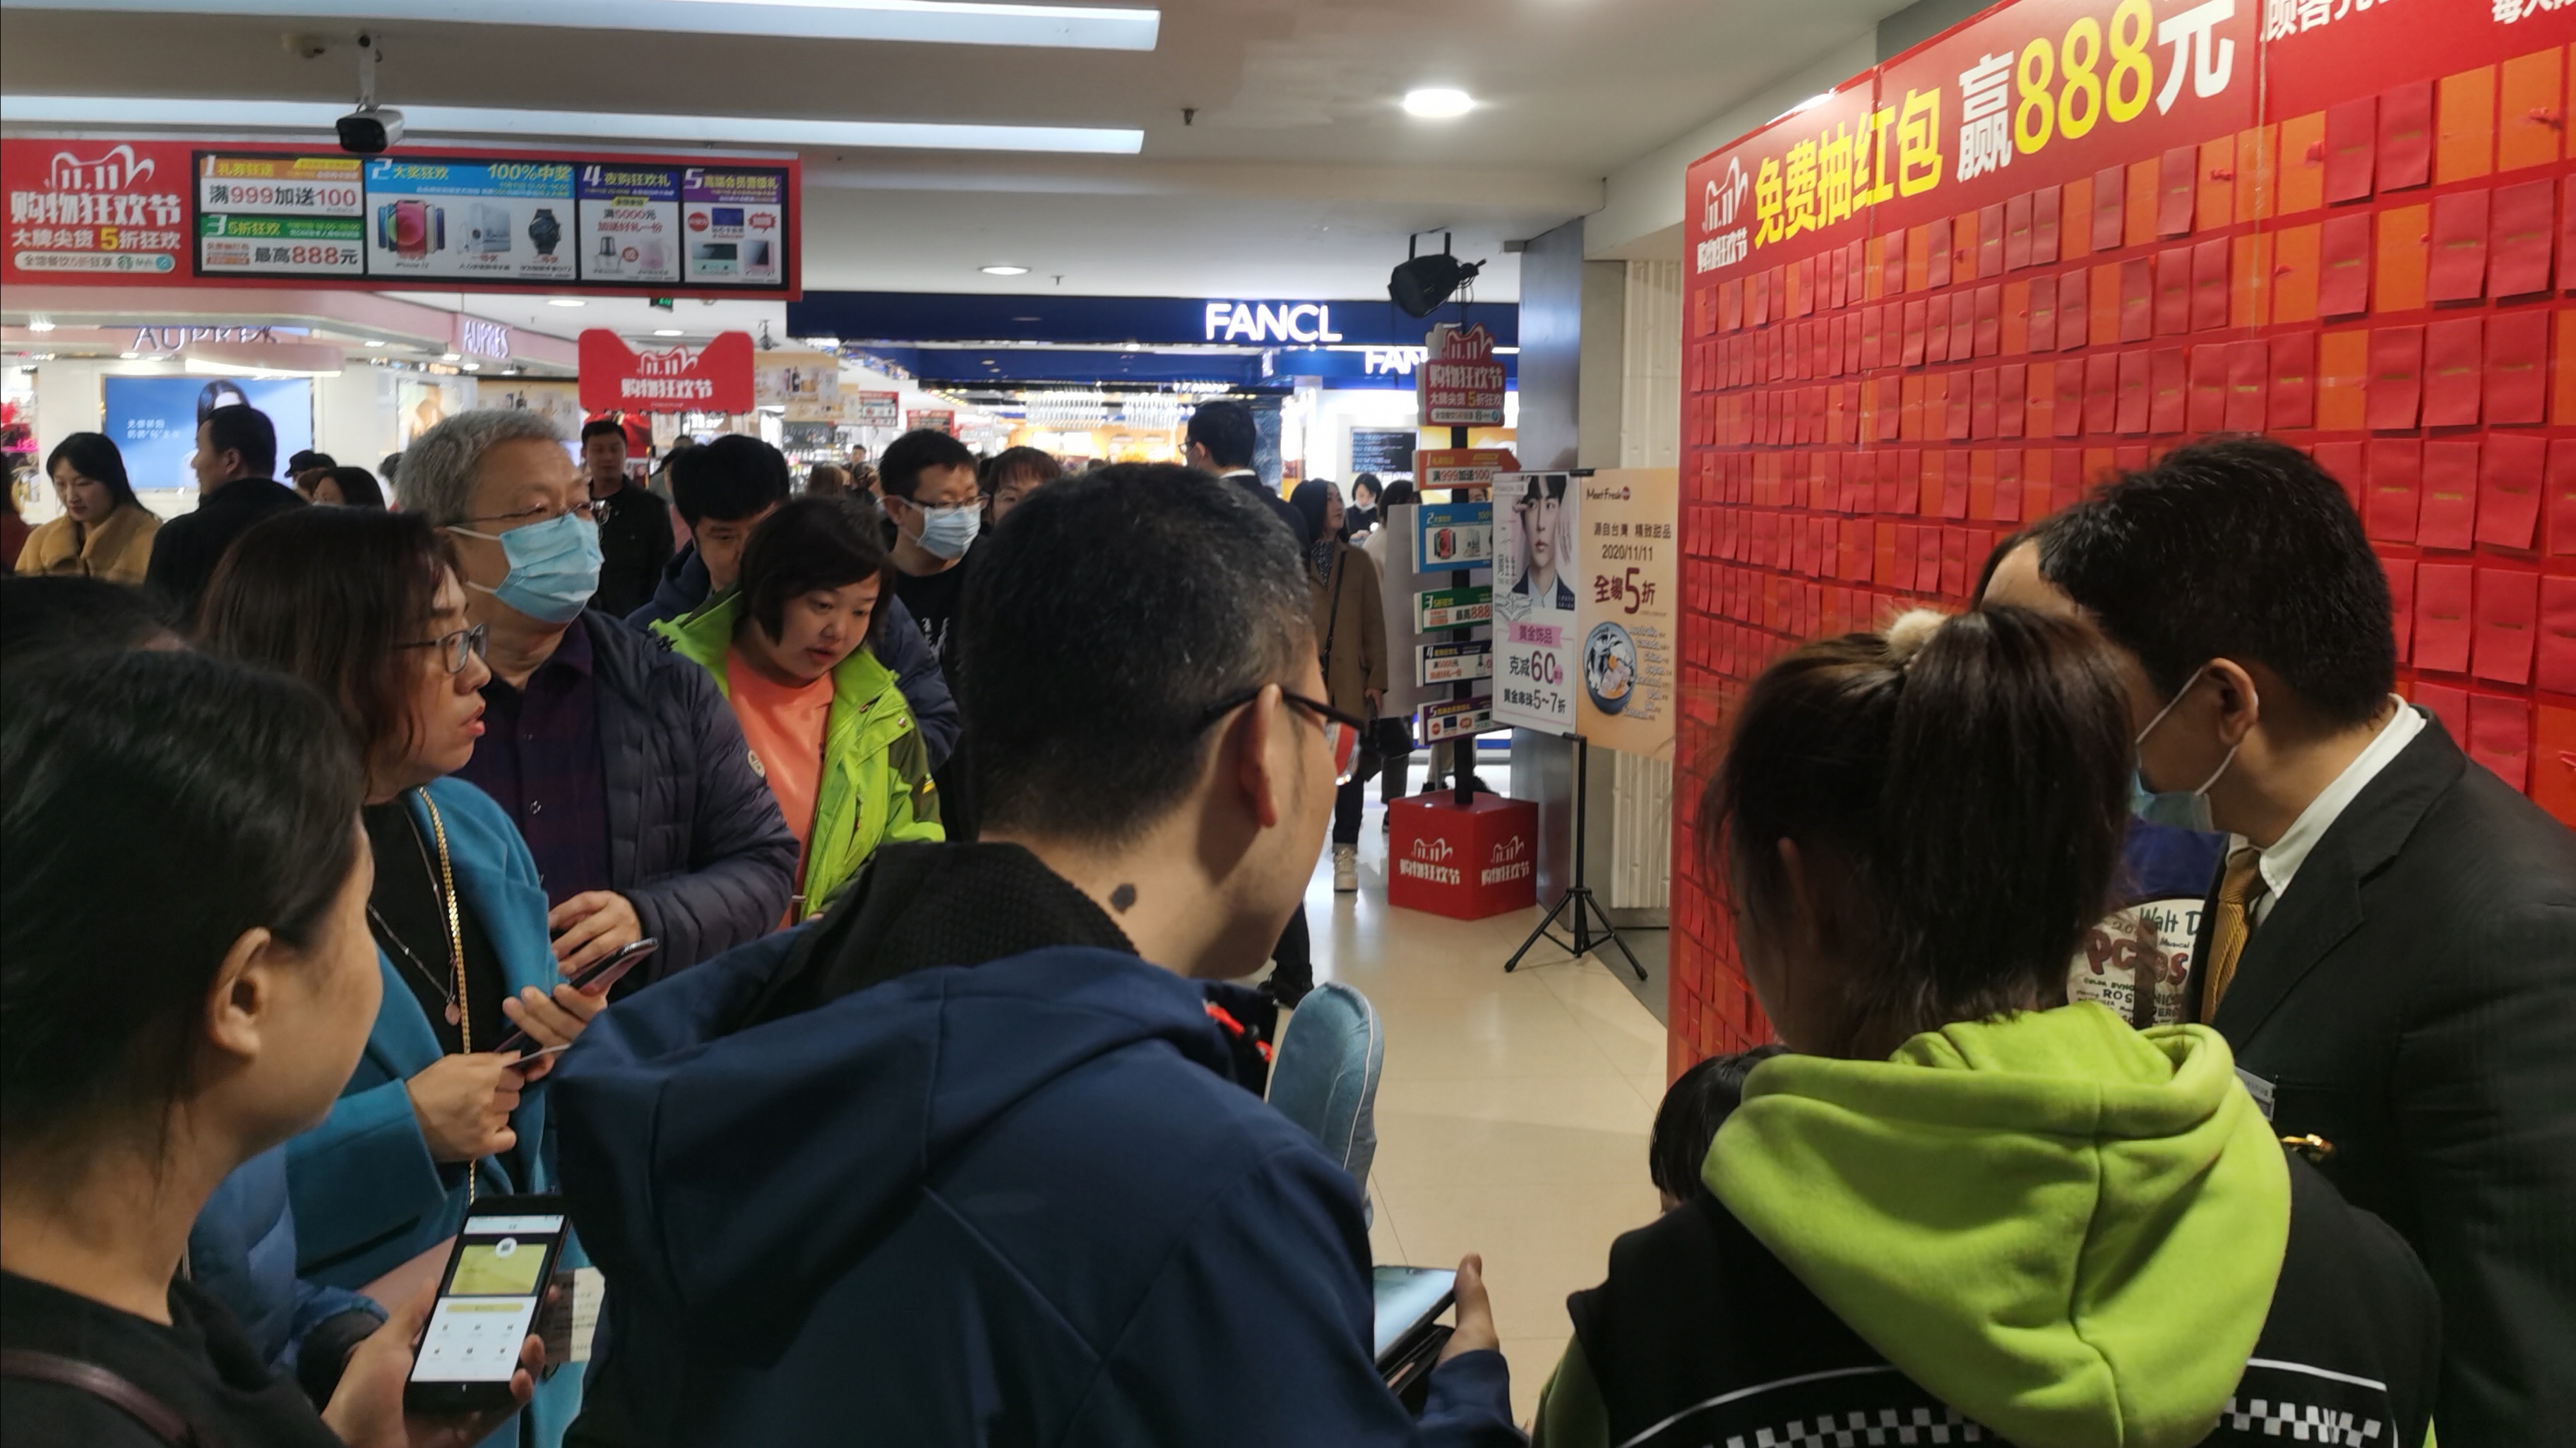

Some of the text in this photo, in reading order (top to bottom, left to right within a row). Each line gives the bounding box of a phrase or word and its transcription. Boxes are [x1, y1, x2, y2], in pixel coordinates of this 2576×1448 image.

[371, 157, 393, 181] 2
[487, 163, 573, 181] 100%中奖
[583, 166, 602, 186] 4
[683, 168, 705, 189] 5
[1754, 86, 1943, 250] 免费抽红包
[210, 185, 356, 208] 满999加送100
[11, 191, 181, 227] 购物狂欢节
[11, 228, 94, 249] 大牌尖货
[100, 227, 181, 250] 5折狂欢
[1697, 227, 1748, 274] 购物狂欢节
[254, 246, 359, 265] 最高888元
[1205, 303, 1342, 342] FANCL
[621, 378, 713, 399] 购物狂欢节
[1429, 364, 1503, 389] 购物狂欢节
[1602, 544, 1653, 561] 2020/11/11
[1400, 858, 1460, 885] 购物狂欢节
[1481, 860, 1530, 886] 购物狂欢节
